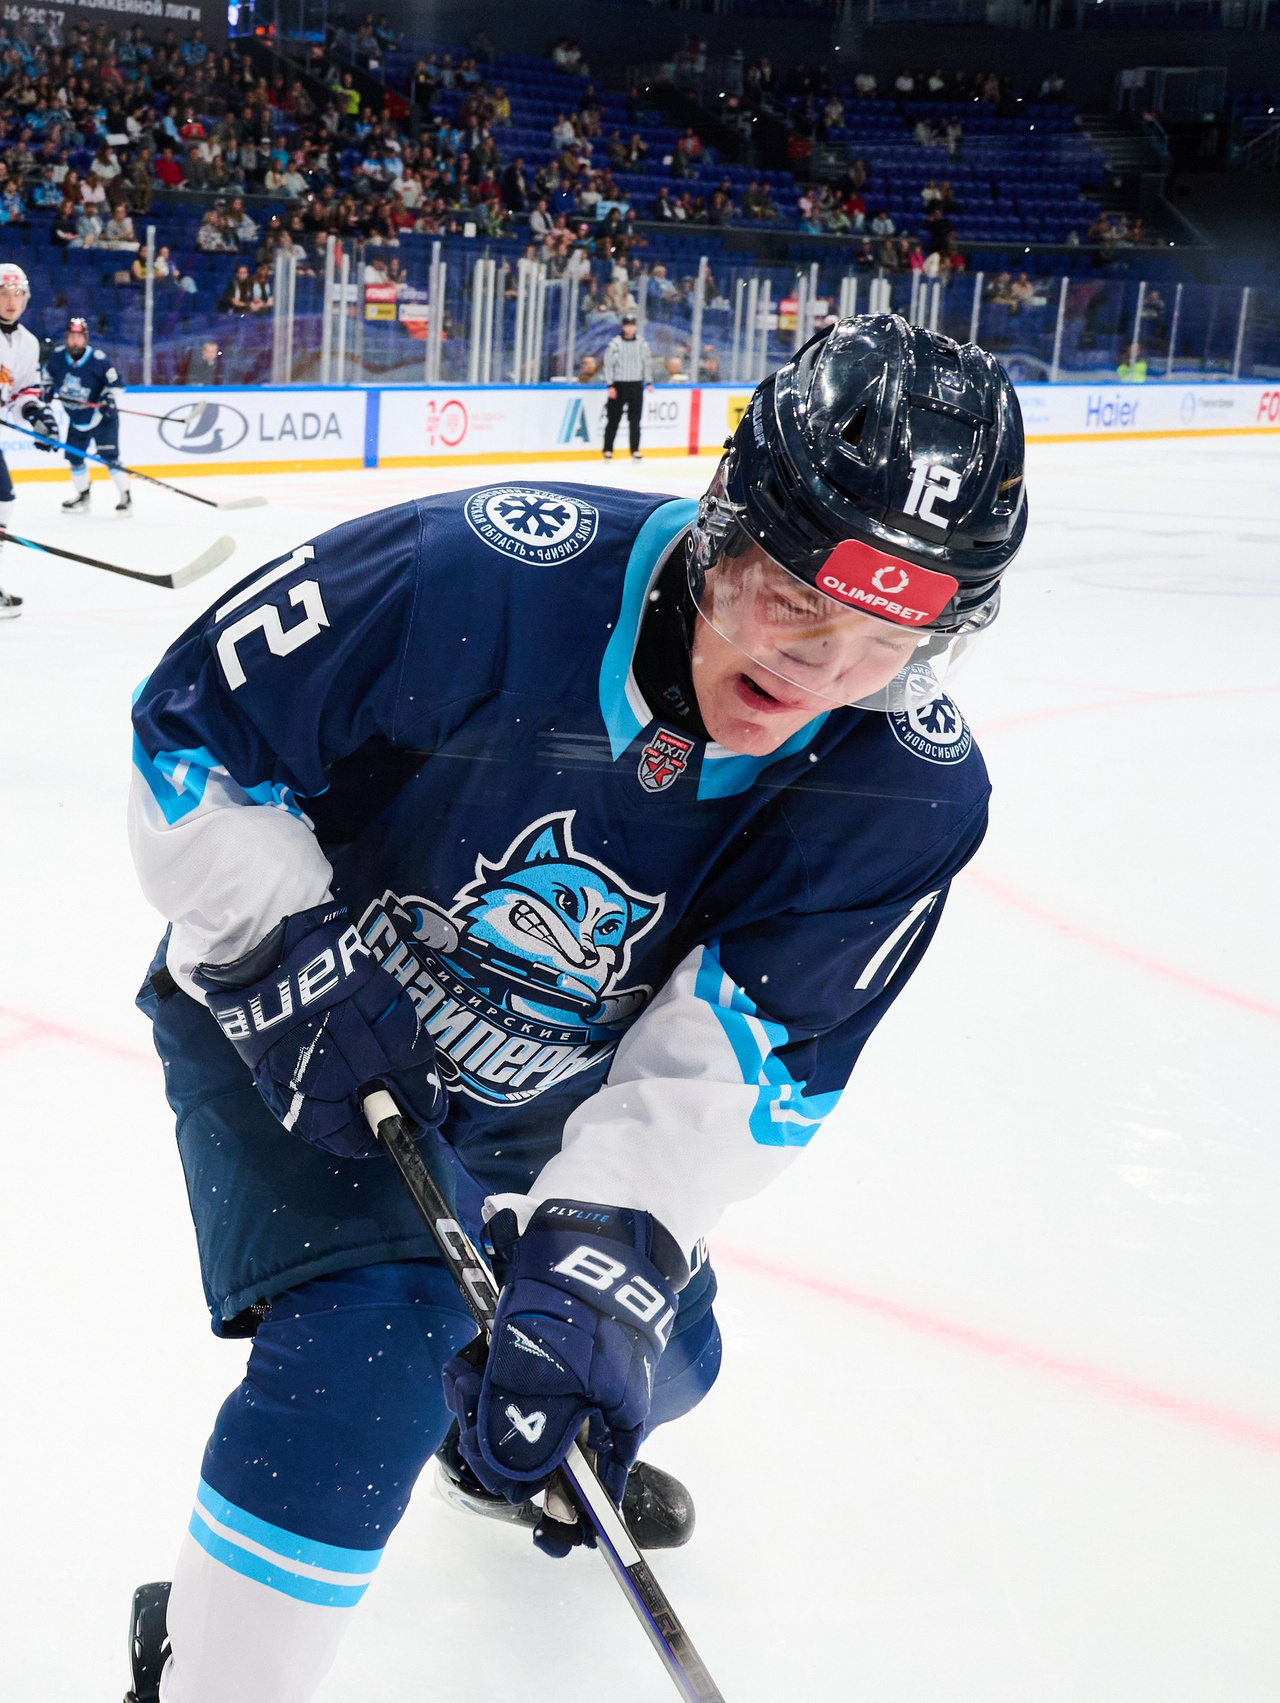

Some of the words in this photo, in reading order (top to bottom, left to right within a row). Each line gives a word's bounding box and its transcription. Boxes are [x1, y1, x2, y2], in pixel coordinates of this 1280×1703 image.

[260, 412, 342, 441] LADA
[1086, 392, 1140, 428] Haier
[902, 458, 962, 530] 12
[480, 523, 527, 556] ОБЛАСТЬ
[575, 517, 593, 542] КЛУБ
[536, 538, 580, 561] СИБИРЬ
[822, 575, 929, 621] OLIMPBET
[214, 544, 331, 692] 12
[654, 740, 685, 760] МХЛ
[425, 957, 572, 1041] СИБИРСКИЕ
[547, 1206, 610, 1223] FLYLITE
